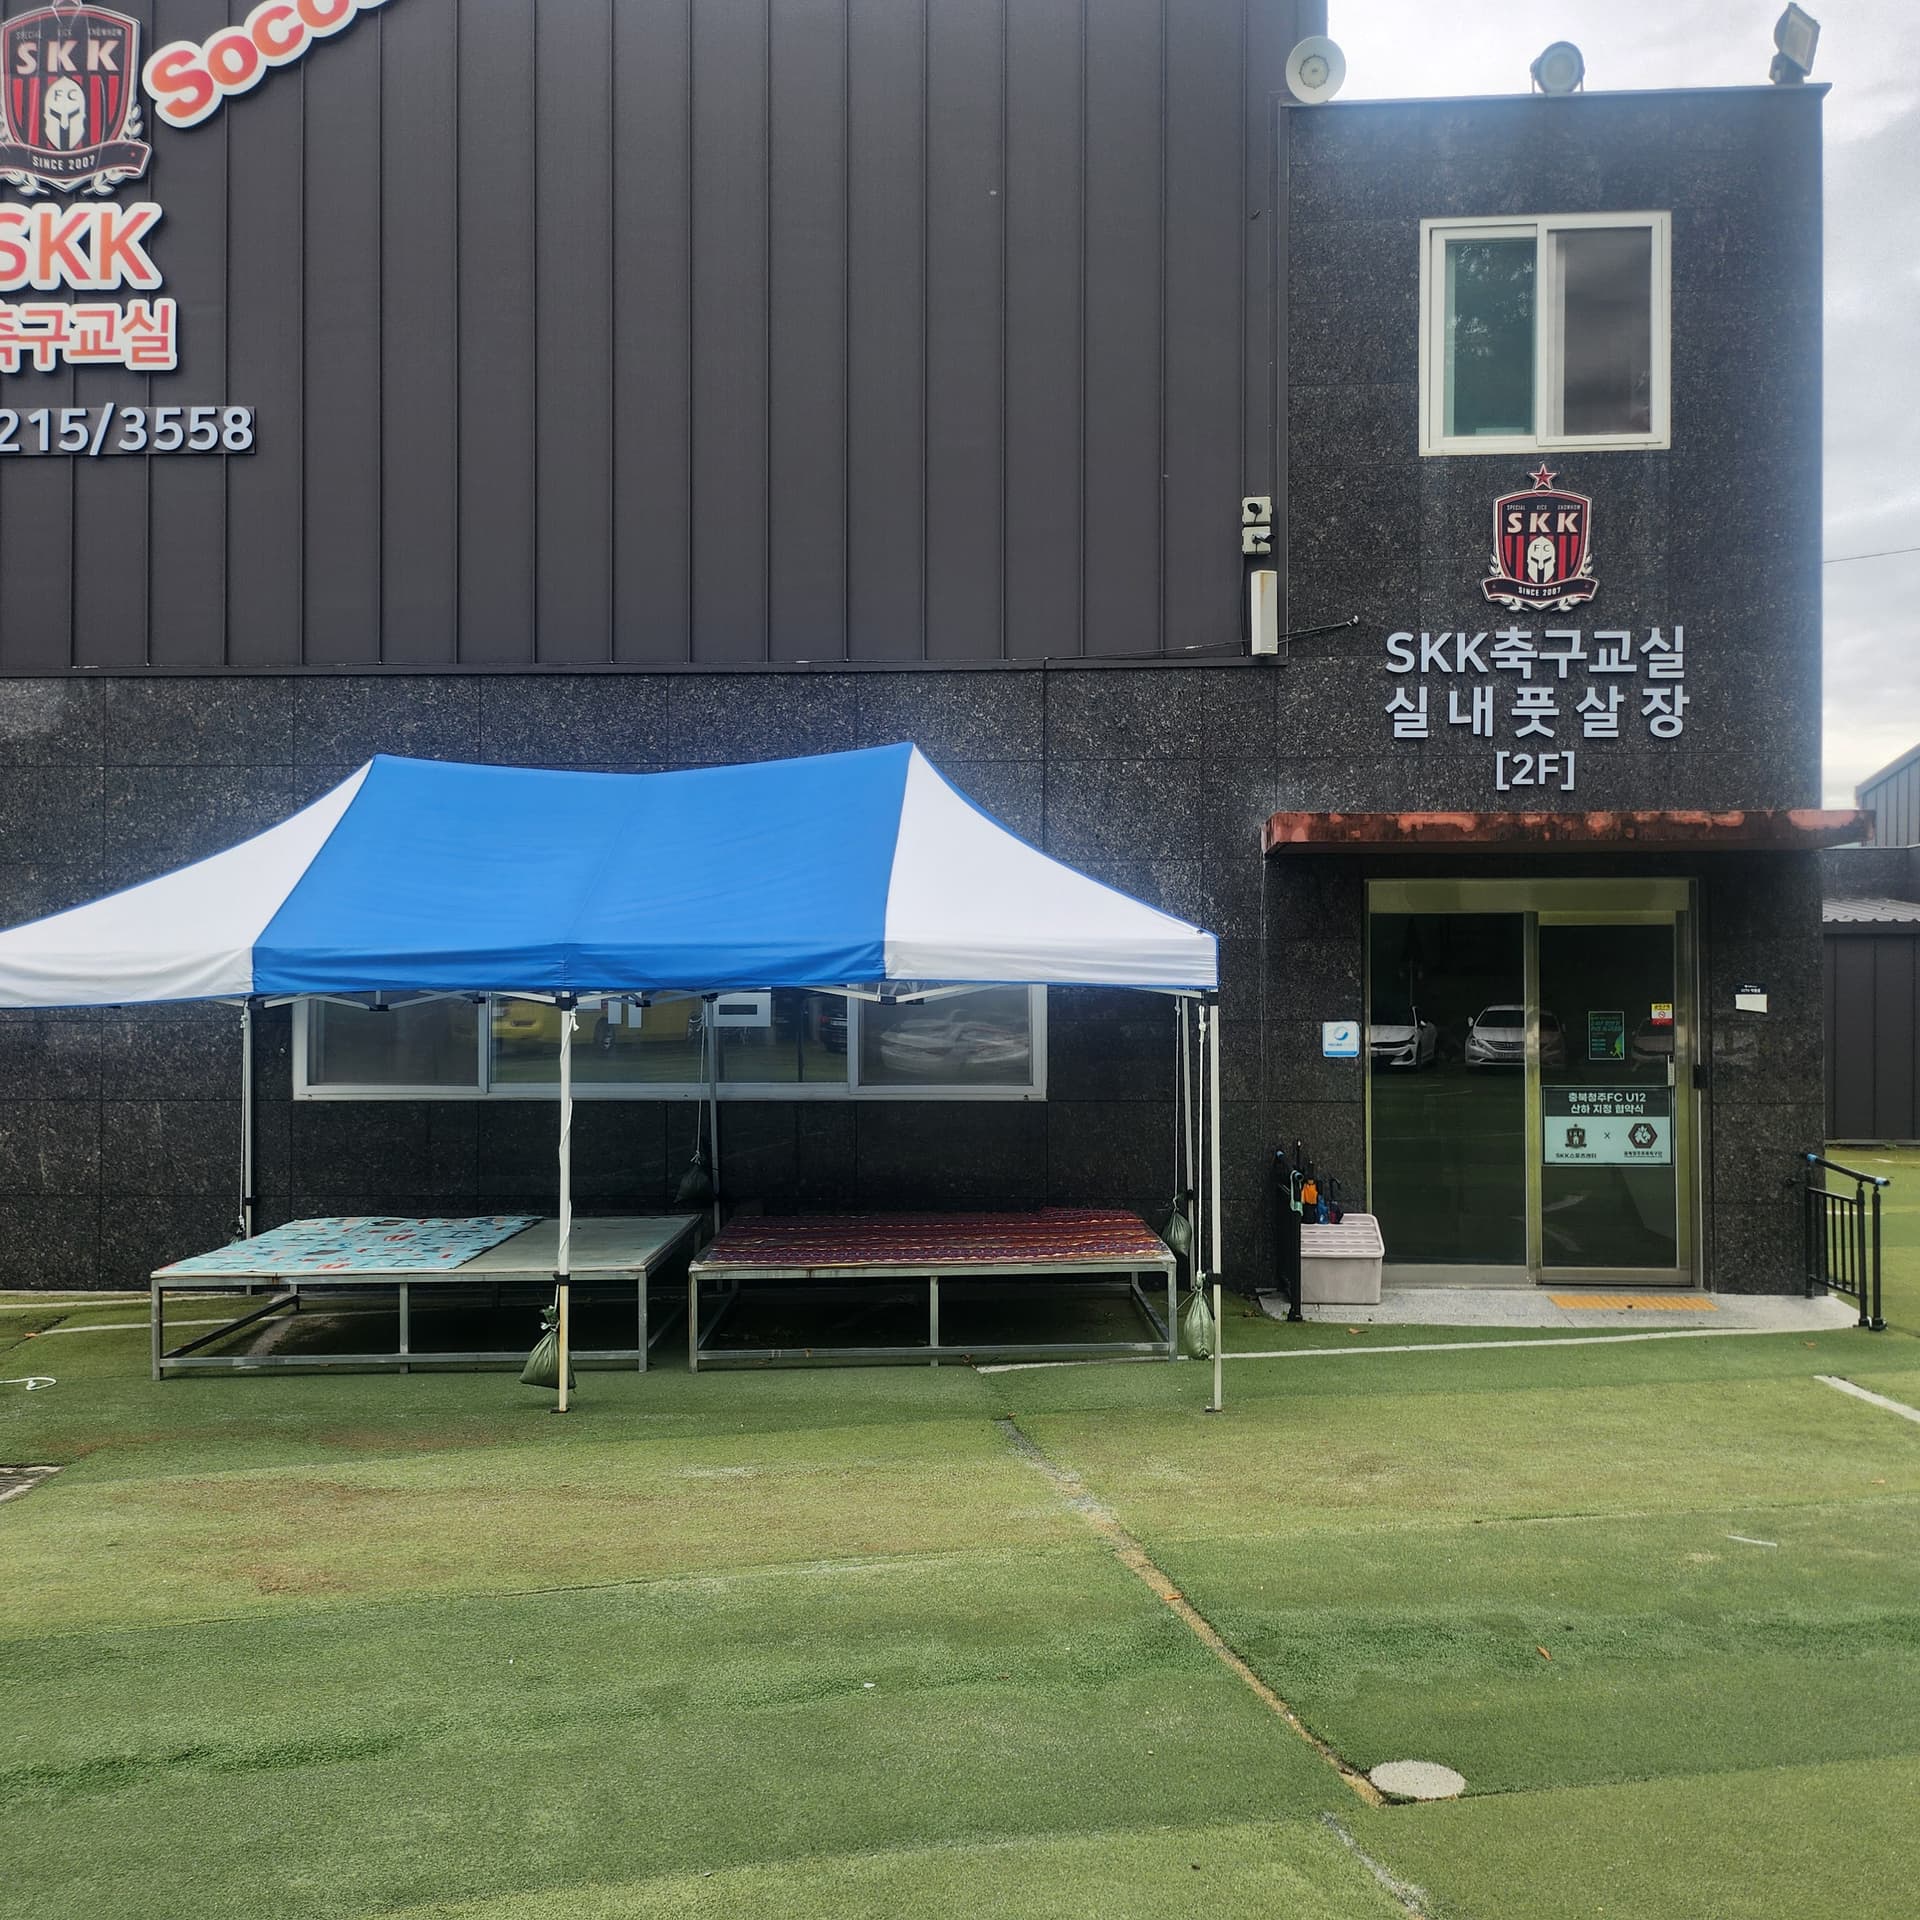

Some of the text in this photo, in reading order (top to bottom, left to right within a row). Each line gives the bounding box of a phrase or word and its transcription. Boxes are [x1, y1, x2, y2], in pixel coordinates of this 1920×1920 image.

[16, 40, 120, 75] SKK
[54, 89, 77, 102] FC
[32, 155, 96, 170] SINCE 2007
[0, 212, 152, 282] SKK
[1507, 512, 1579, 533] SKK
[1533, 544, 1551, 553] FC
[1518, 586, 1561, 597] SINCE 2007
[1385, 625, 1685, 679] SKK축구교실
[1495, 751, 1575, 791] [2F]
[1625, 1092, 1647, 1103] U12
[1570, 1104, 1590, 1114] 산하
[1593, 1104, 1612, 1114] 지정
